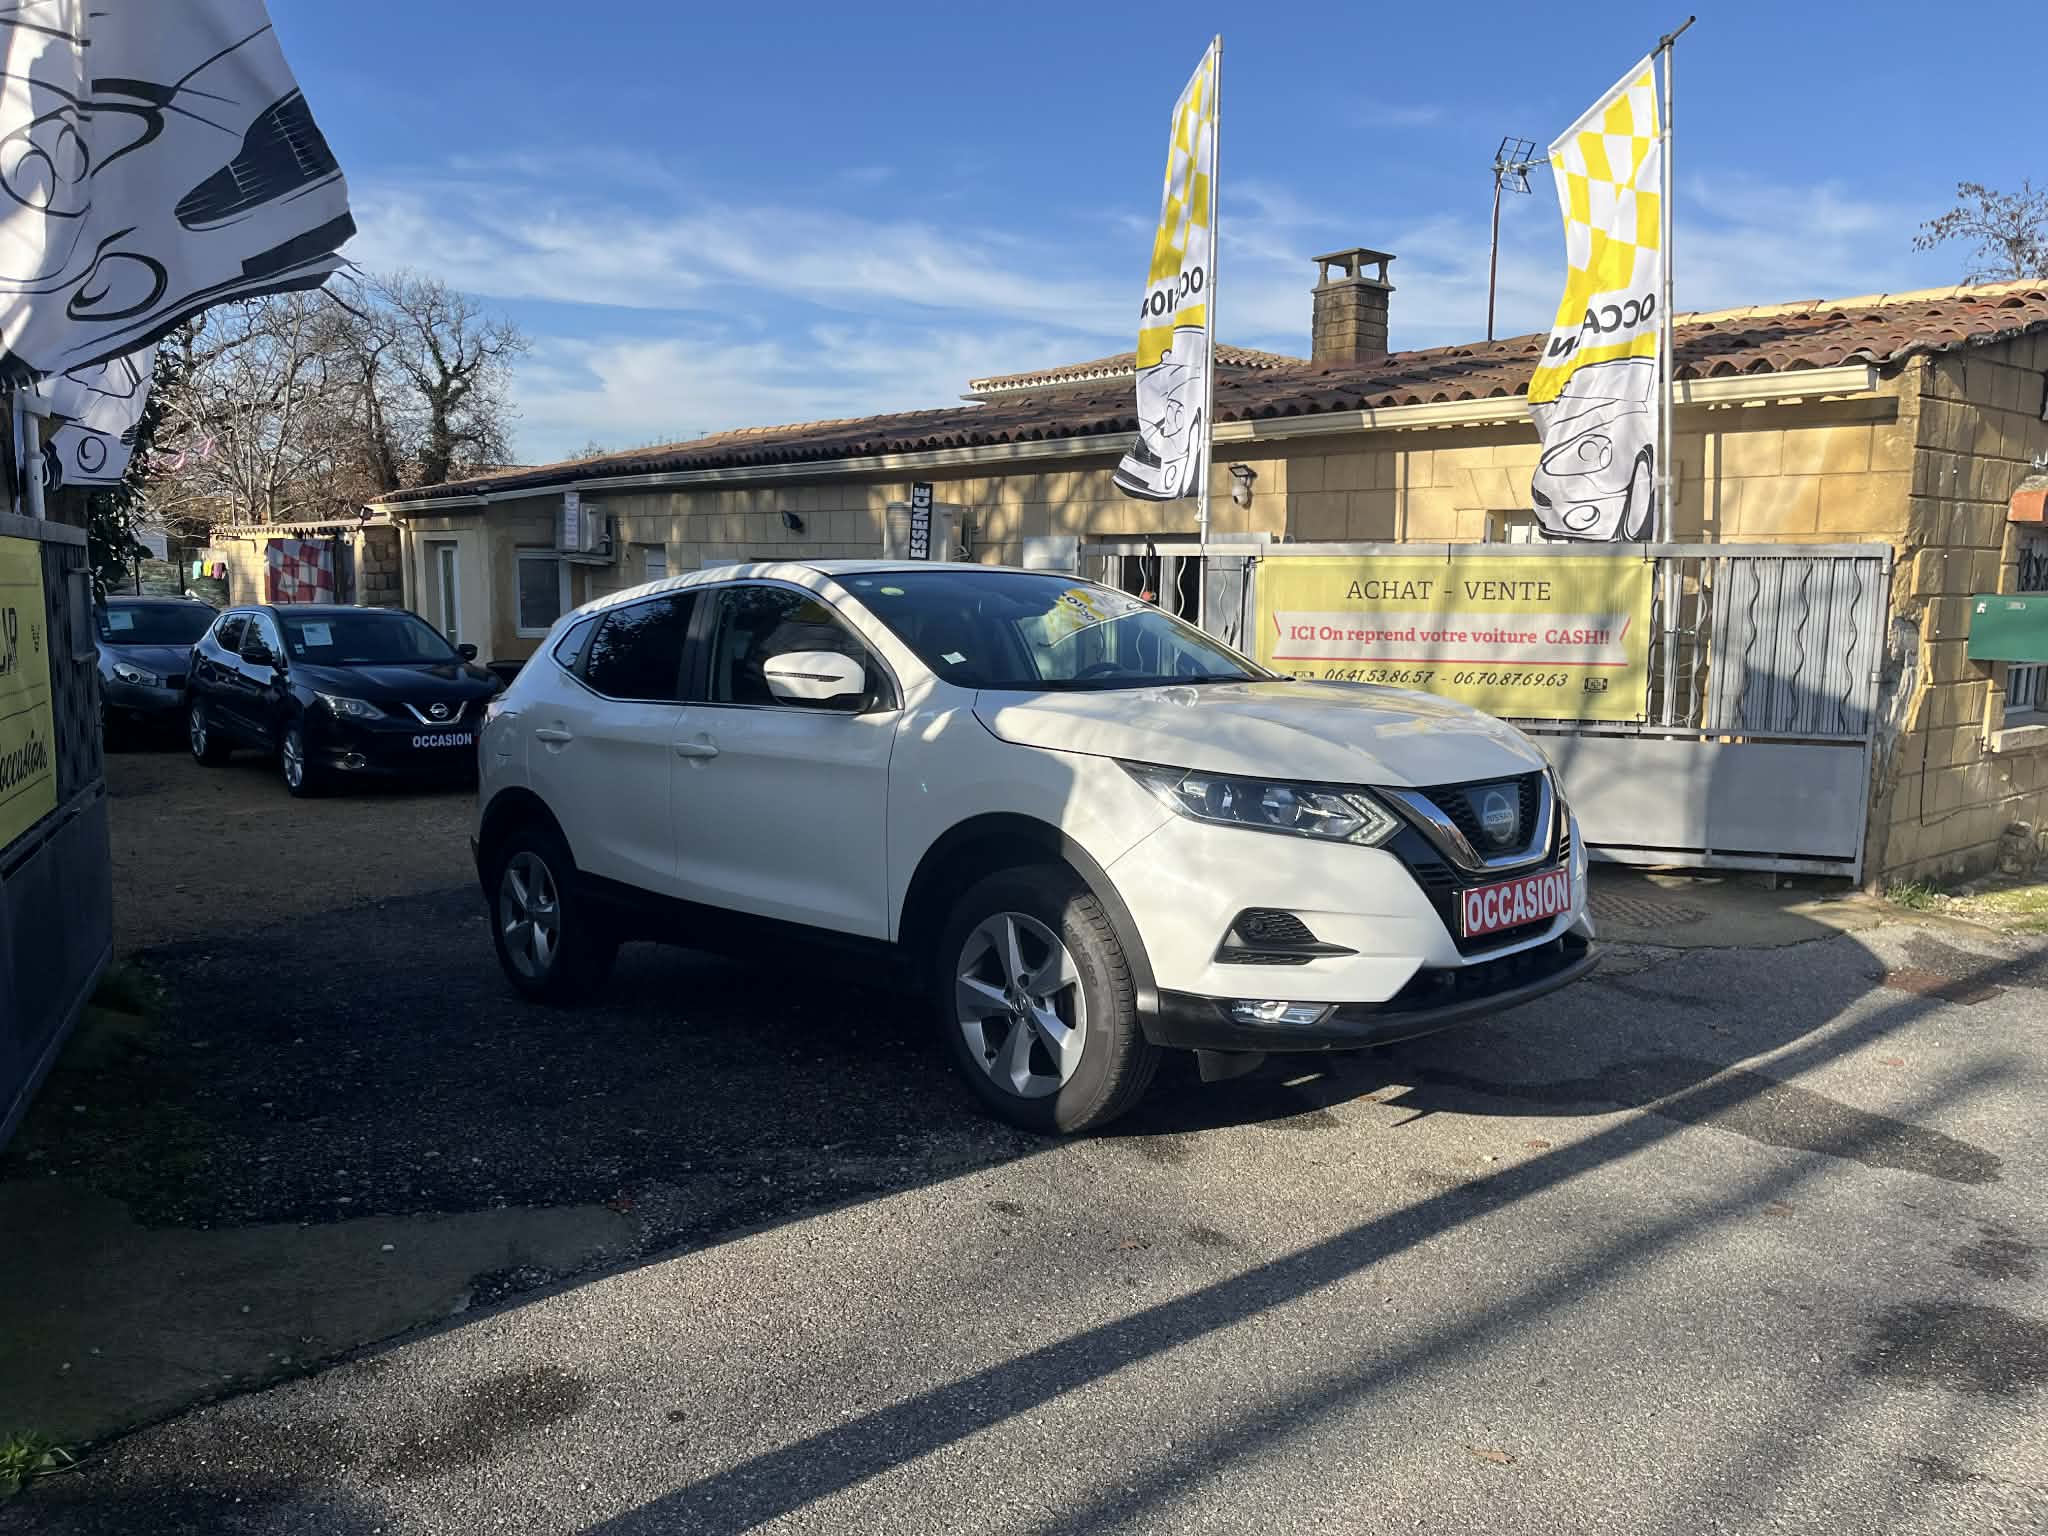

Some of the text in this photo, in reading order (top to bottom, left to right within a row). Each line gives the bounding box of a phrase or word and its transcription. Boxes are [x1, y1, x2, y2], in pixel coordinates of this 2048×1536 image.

[910, 487, 931, 559] ESSENCE
[1345, 580, 1433, 600] ACHAT
[1464, 581, 1551, 601] VENTE
[1290, 625, 1610, 645] ICI On reprend votre voiture CASH!!
[412, 732, 473, 748] OCCASION
[1467, 873, 1568, 932] OCCASION
